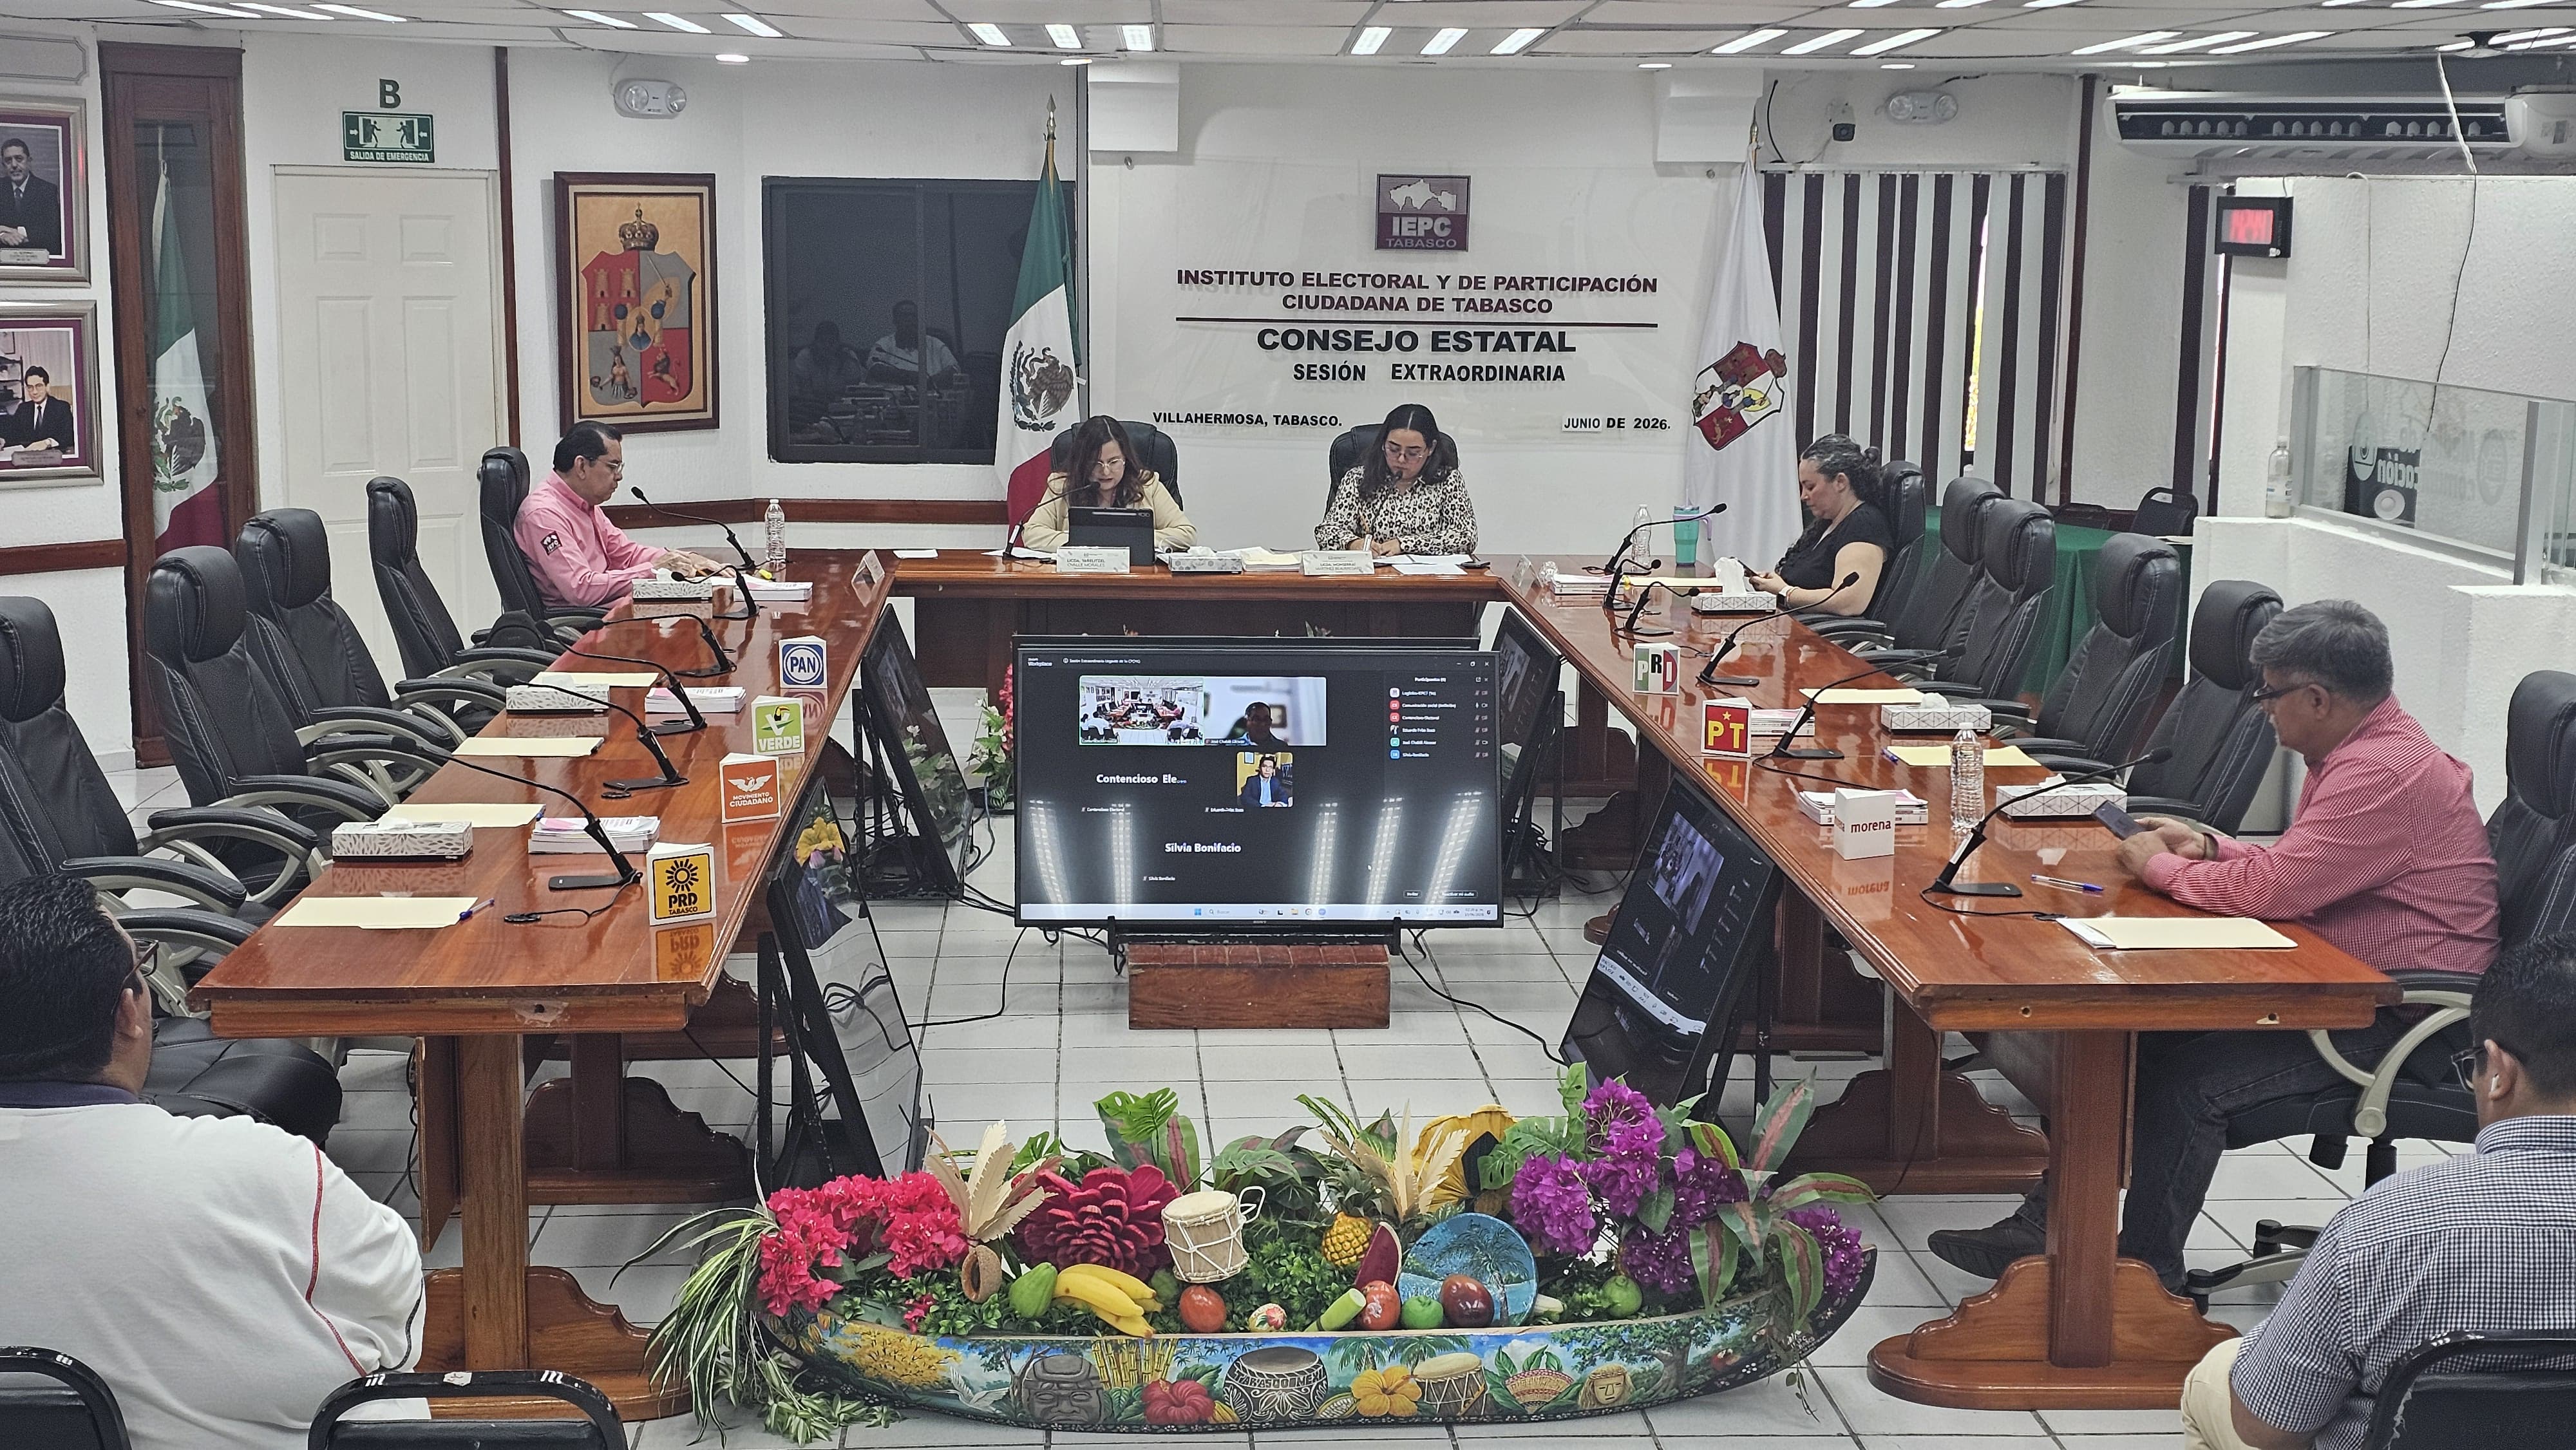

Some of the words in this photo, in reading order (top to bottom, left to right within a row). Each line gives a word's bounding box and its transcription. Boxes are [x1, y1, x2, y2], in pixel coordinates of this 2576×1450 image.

[379, 79, 401, 108] B
[350, 151, 374, 160] SALIDA
[375, 152, 385, 160] DE
[386, 152, 429, 162] EMERGENCIA
[1392, 216, 1452, 237] IEPC
[1386, 238, 1457, 248] TABASCO
[1177, 269, 1294, 287] INSTITUTO
[1302, 272, 1429, 290] ELECTORAL
[1436, 275, 1451, 290] Y
[1458, 276, 1486, 290] DE
[1493, 274, 1657, 292] PARTICIPACIÓN
[1283, 294, 1409, 312] CIUDADANA
[1416, 297, 1444, 312] DE
[1452, 297, 1553, 314] TABASCO
[1257, 328, 1419, 352] CONSEJO
[1431, 330, 1576, 352] ESTATAL
[1293, 361, 1365, 381] SESIÓN
[1391, 363, 1566, 382] EXTRAORDINARIA
[1153, 412, 1268, 427] VILLAHERMOSA,
[1273, 415, 1342, 426] TABASCO.
[1564, 417, 1600, 429] JUNIO
[1606, 417, 1625, 428] DE
[1633, 418, 1671, 430] 2026.
[790, 656, 816, 673] PAN
[1638, 654, 1672, 683] PRI
[1708, 720, 1745, 749] PT
[759, 735, 800, 752] VERDE
[1096, 774, 1158, 784] Contencioso
[730, 796, 773, 807] CIUDADANO
[733, 791, 770, 801] MOVIMIENTO
[1851, 820, 1891, 833] morena
[1165, 842, 1192, 852] Silvia
[1194, 842, 1242, 852] Bonifacio
[668, 893, 698, 909] PRD
[668, 906, 698, 915] TABASCO
